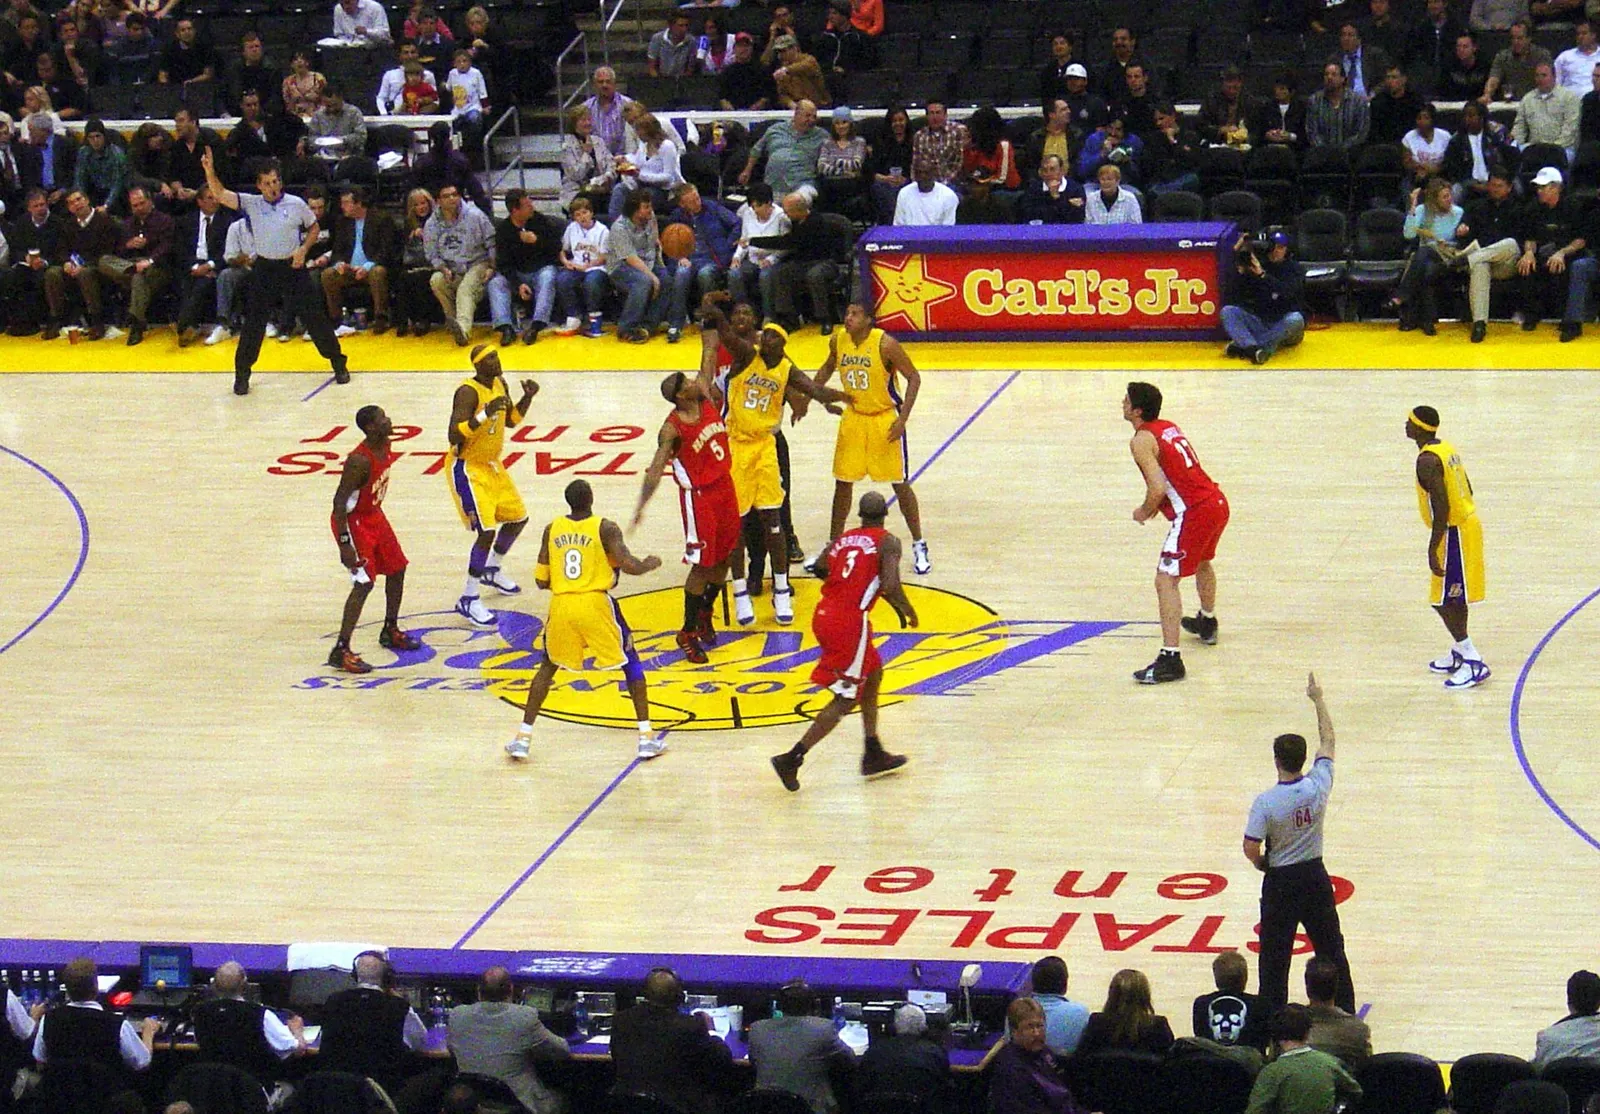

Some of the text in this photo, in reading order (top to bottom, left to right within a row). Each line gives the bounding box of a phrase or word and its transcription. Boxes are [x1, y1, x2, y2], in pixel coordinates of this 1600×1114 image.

[963, 268, 1215, 316] Carl's Jr.
[846, 370, 869, 390] 43
[744, 388, 771, 412] 54
[710, 439, 725, 461] 5
[554, 533, 593, 549] BRYANT
[564, 548, 582, 580] 8
[842, 550, 859, 579] 3
[1295, 807, 1312, 827] 64
[777, 865, 1354, 905] enter
